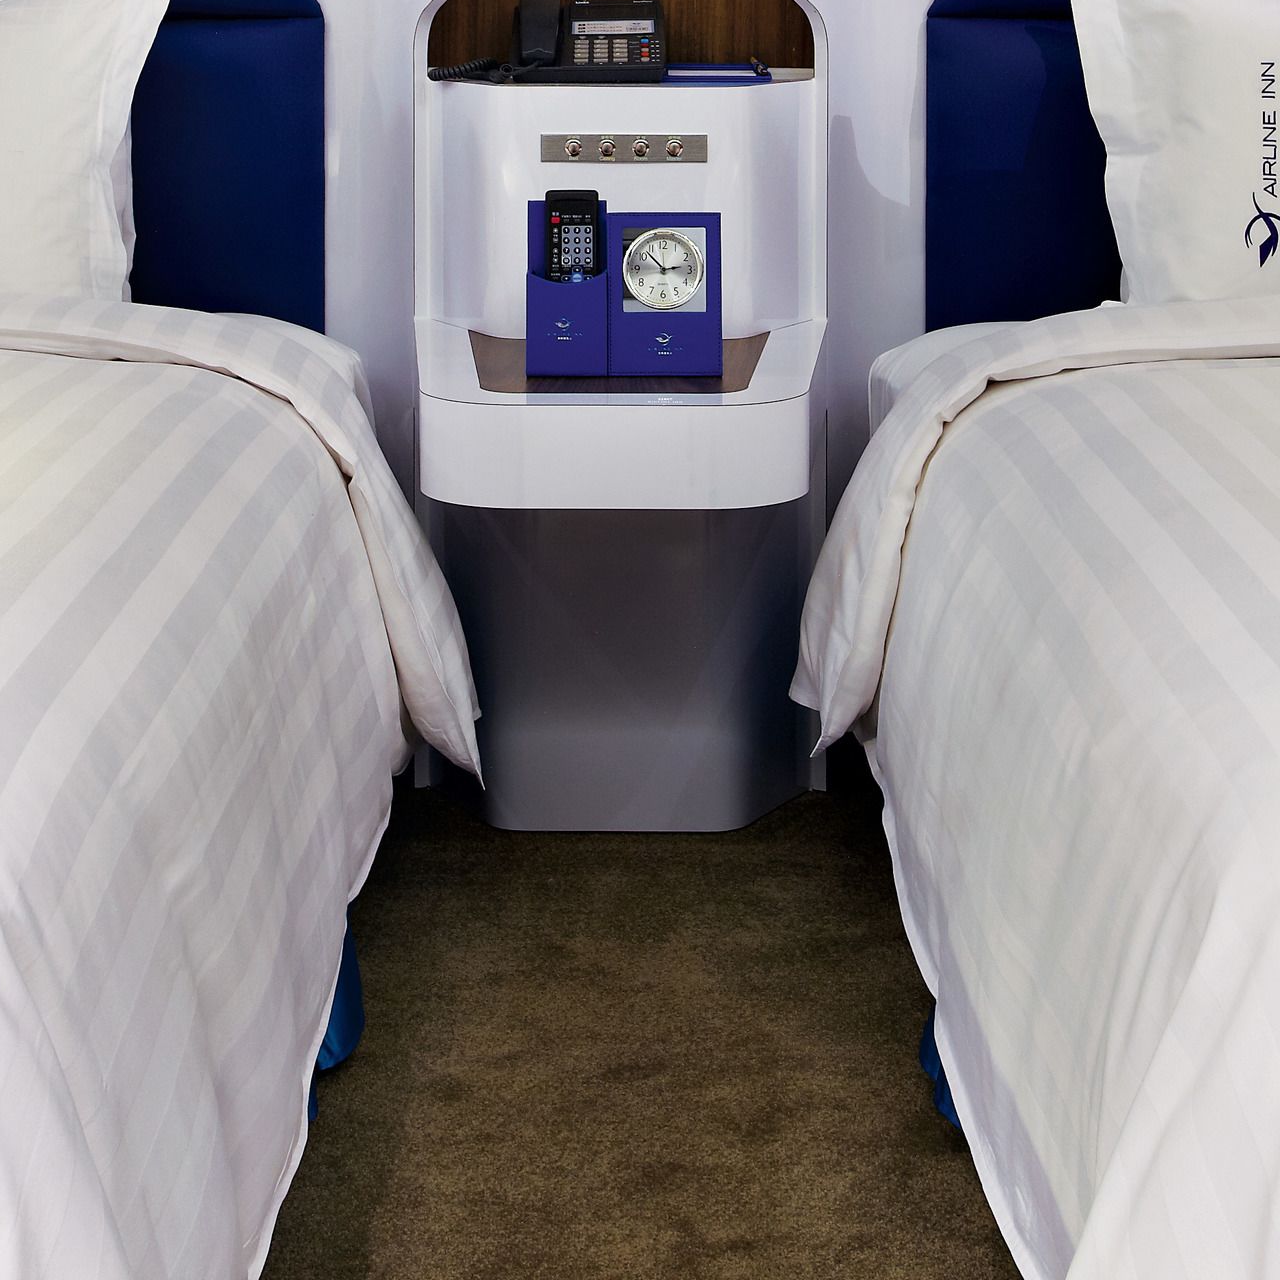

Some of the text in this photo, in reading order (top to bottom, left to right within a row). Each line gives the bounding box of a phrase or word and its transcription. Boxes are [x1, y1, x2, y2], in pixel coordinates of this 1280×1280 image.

[1260, 62, 1278, 198] AIRLINE INN
[648, 244, 654, 253] 11
[659, 240, 668, 250] 12
[639, 252, 648, 261] 10
[683, 252, 689, 262] 2
[634, 265, 640, 274] 9
[687, 265, 693, 275] 3
[638, 277, 644, 287] 8
[682, 278, 688, 286] 4
[649, 286, 655, 295] 7
[660, 289, 666, 299] 6
[673, 286, 679, 296] 5
